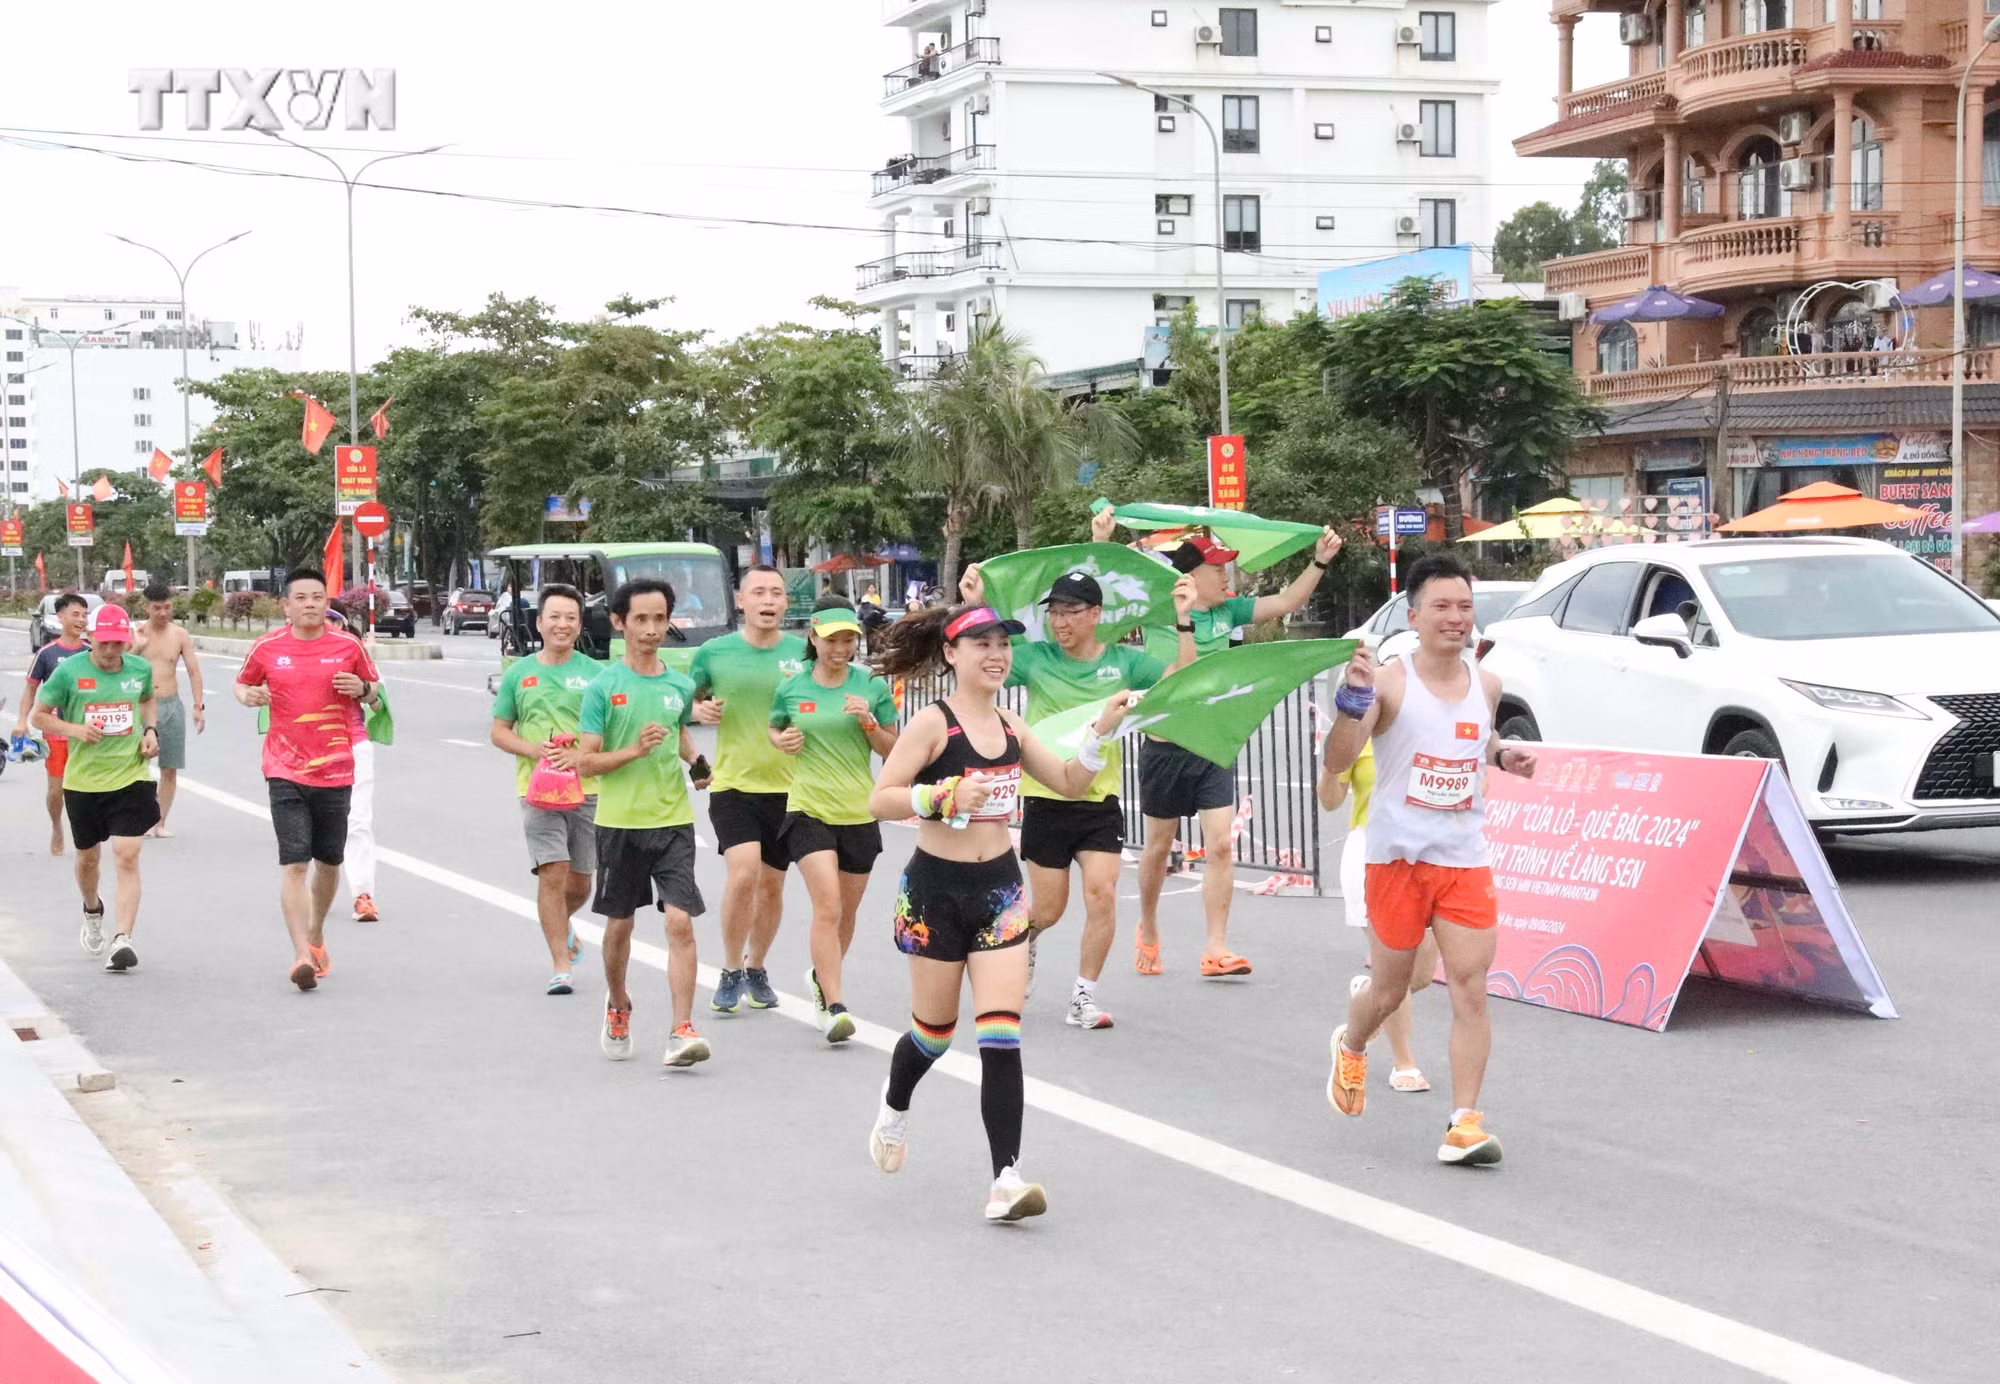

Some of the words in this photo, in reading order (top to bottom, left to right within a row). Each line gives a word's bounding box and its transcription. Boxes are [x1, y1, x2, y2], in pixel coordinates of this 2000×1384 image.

[83, 336, 121, 344] SAMMY
[1880, 484, 1920, 500] BUFET
[1419, 772, 1469, 791] M9989
[1552, 800, 1576, 836] LÒ
[1581, 804, 1619, 842] QUÊ
[1612, 806, 1649, 843] BÁC
[1505, 840, 1553, 877] TRÌNH
[1569, 847, 1614, 885] LÀNG
[1609, 857, 1647, 889] SEN
[1530, 880, 1559, 897] VIETNAM
[1559, 884, 1600, 902] MARATHON
